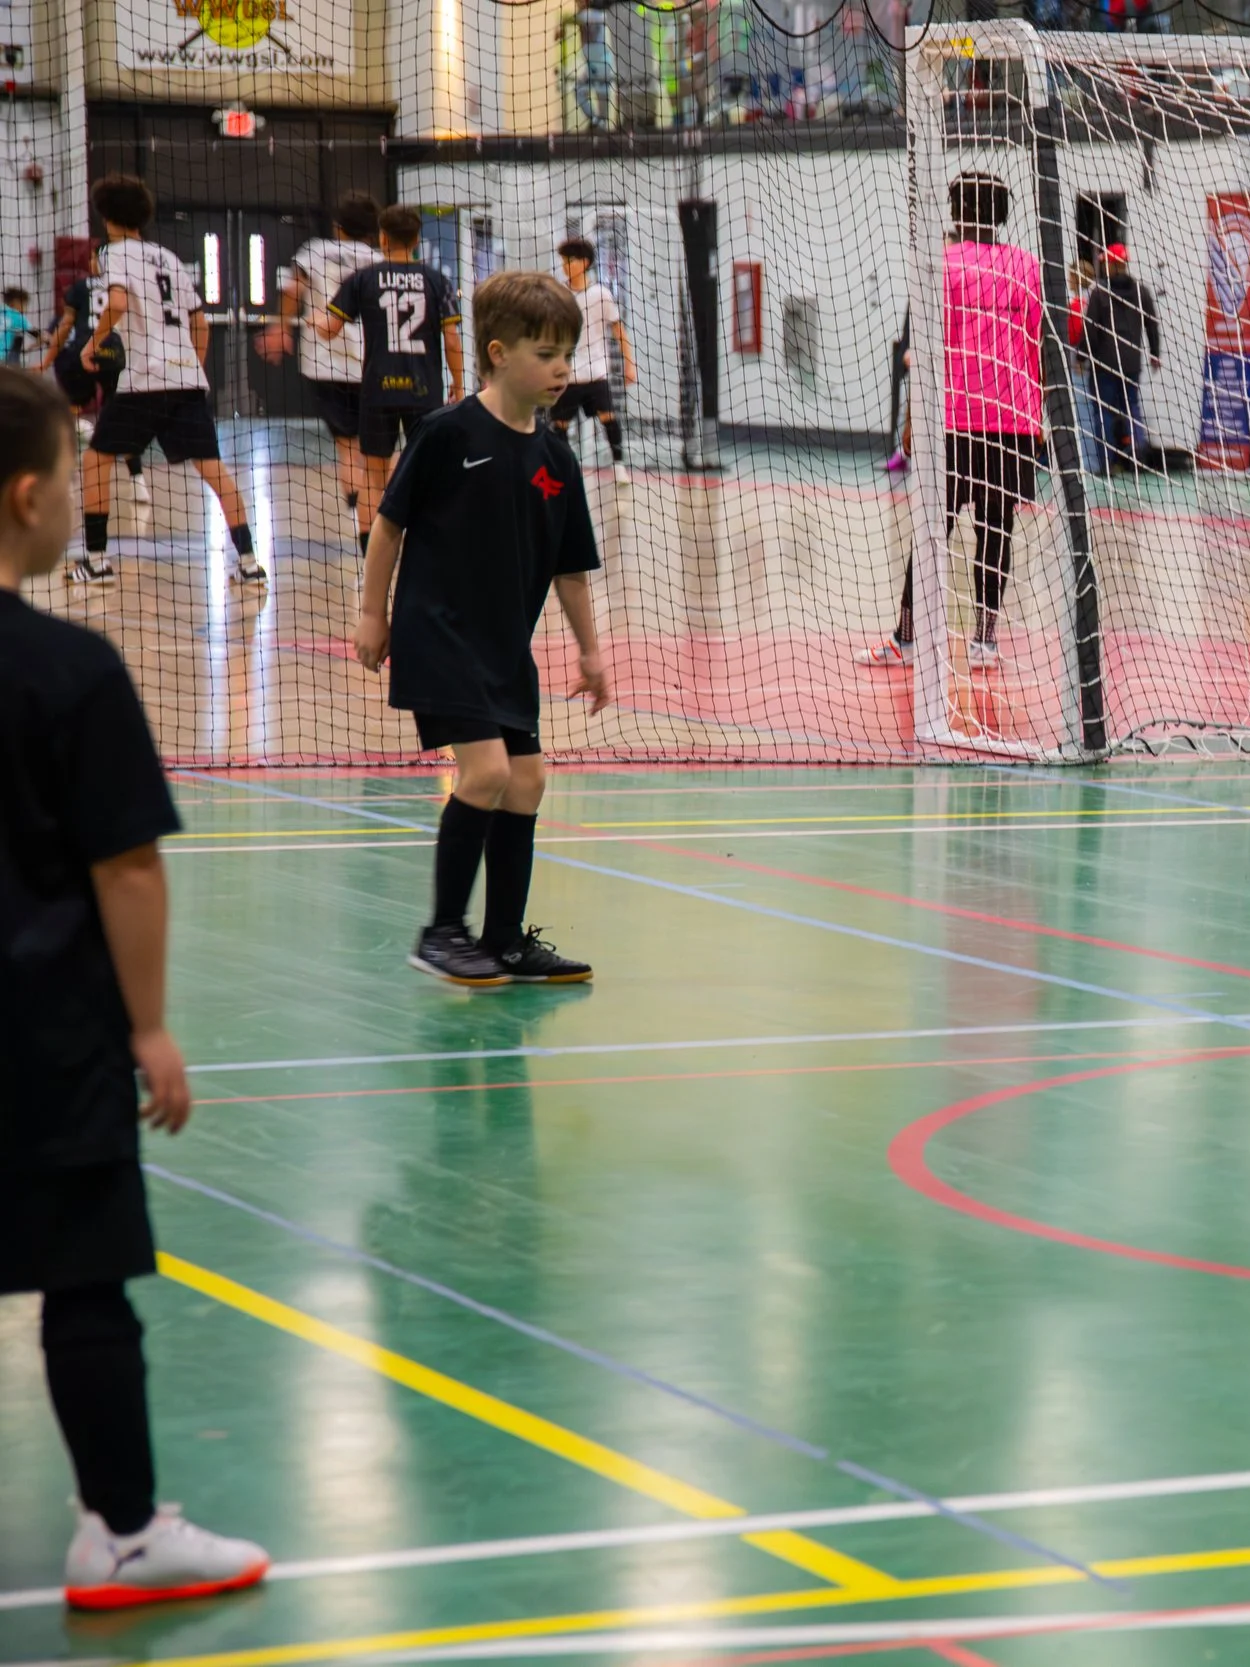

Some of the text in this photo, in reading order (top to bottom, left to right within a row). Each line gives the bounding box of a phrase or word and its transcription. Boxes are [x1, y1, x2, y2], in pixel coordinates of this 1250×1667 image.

[137, 49, 335, 69] www.wwgsl.com
[378, 271, 425, 290] LUCAS
[378, 290, 427, 355] 12
